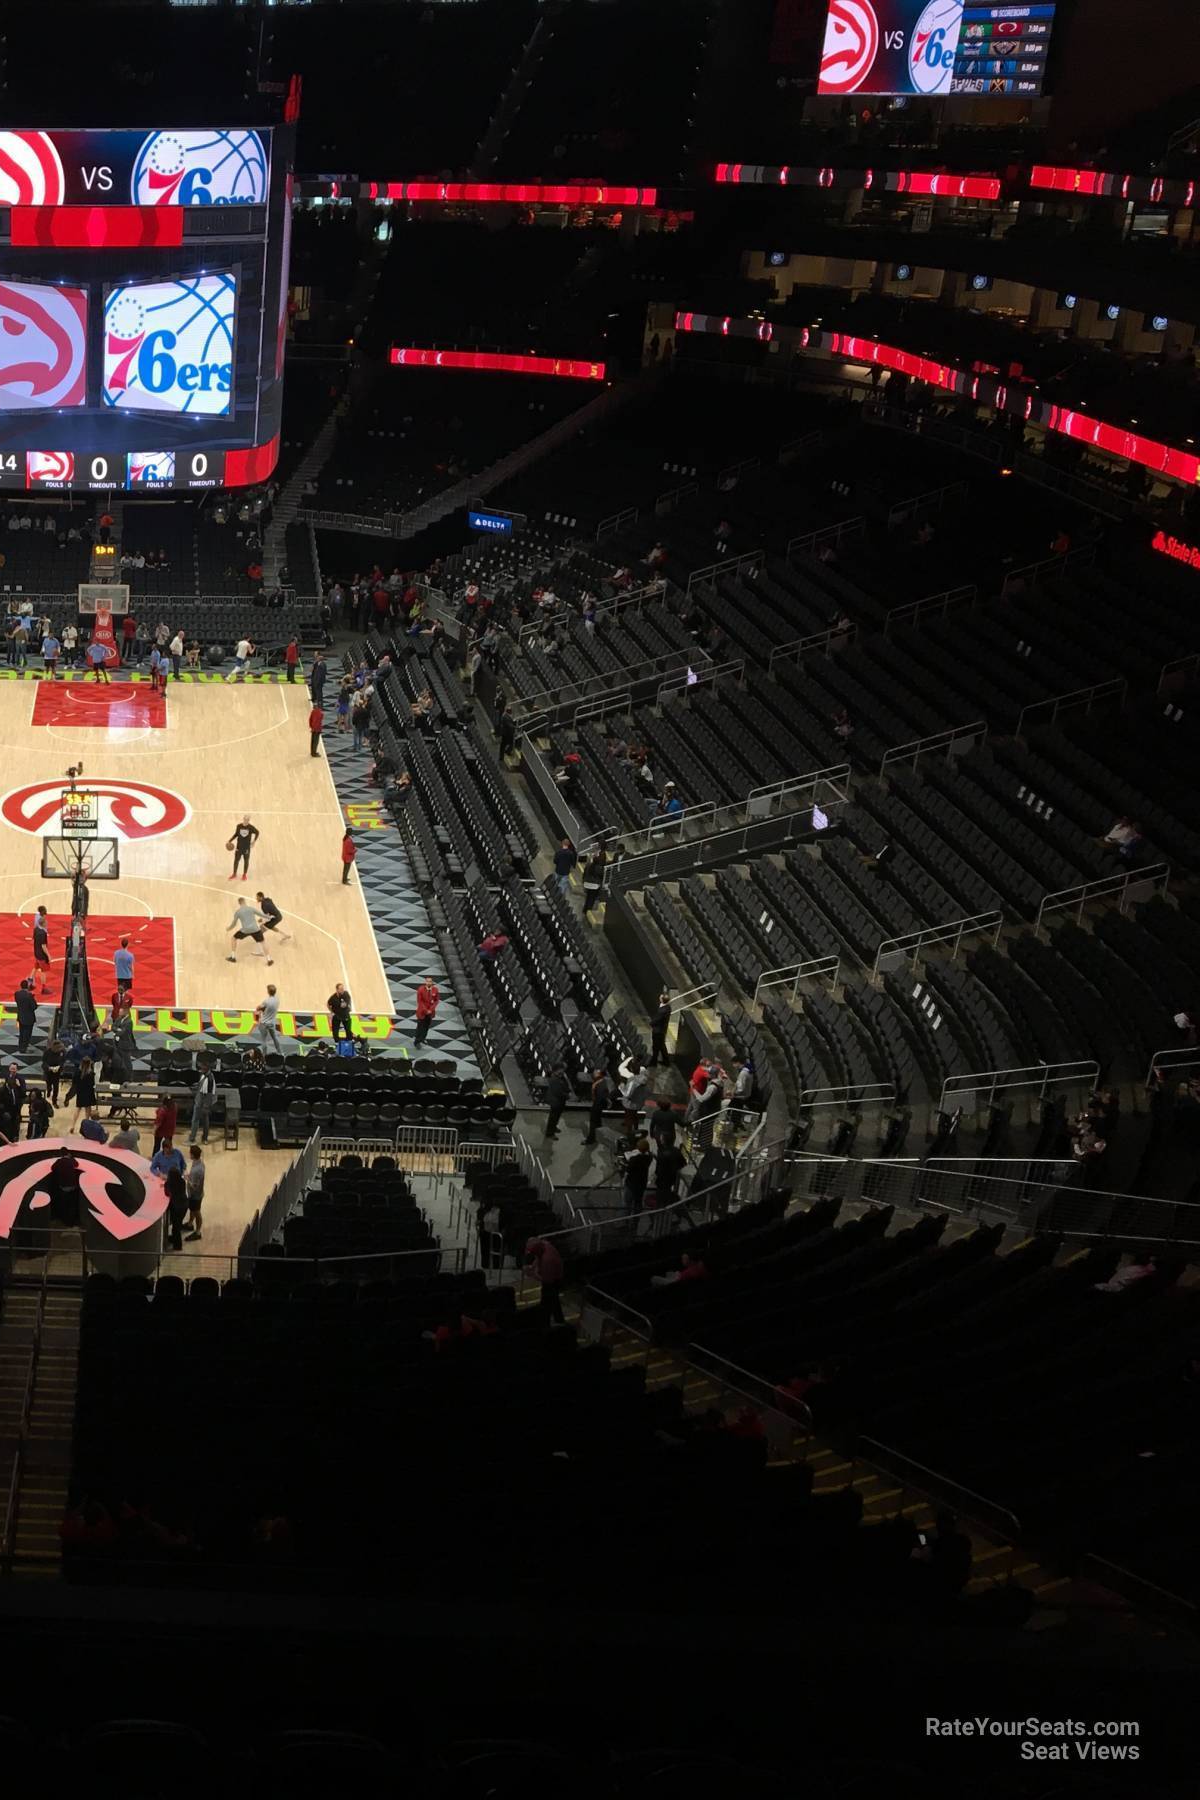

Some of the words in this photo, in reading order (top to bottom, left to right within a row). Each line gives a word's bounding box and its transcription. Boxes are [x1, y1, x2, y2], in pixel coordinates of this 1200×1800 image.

[885, 31, 903, 50] VS
[81, 166, 113, 190] VS
[108, 330, 232, 393] 76ers
[92, 457, 108, 480] 0
[191, 453, 207, 476] 0
[483, 519, 504, 530] DELTA
